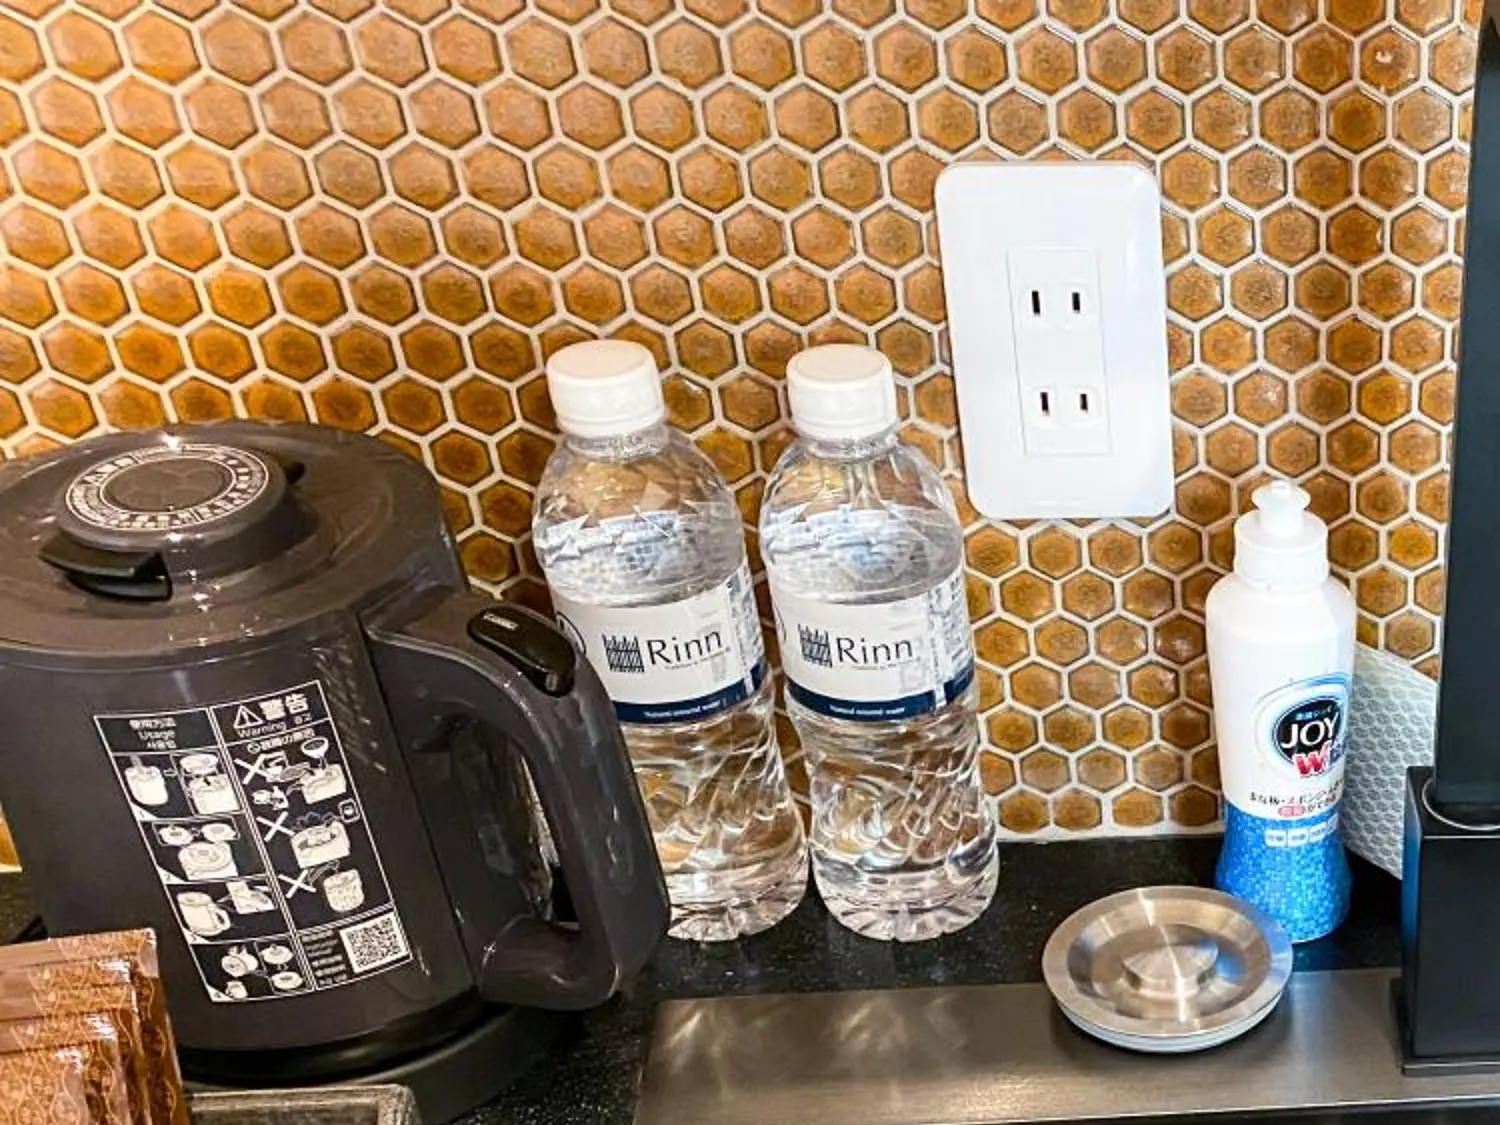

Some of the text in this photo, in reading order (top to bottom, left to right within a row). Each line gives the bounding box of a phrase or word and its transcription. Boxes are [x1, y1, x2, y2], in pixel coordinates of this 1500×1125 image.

[647, 631, 722, 665] Rinn
[836, 637, 914, 664] Rinn
[237, 722, 287, 738] Warning
[1280, 711, 1339, 749] JOY
